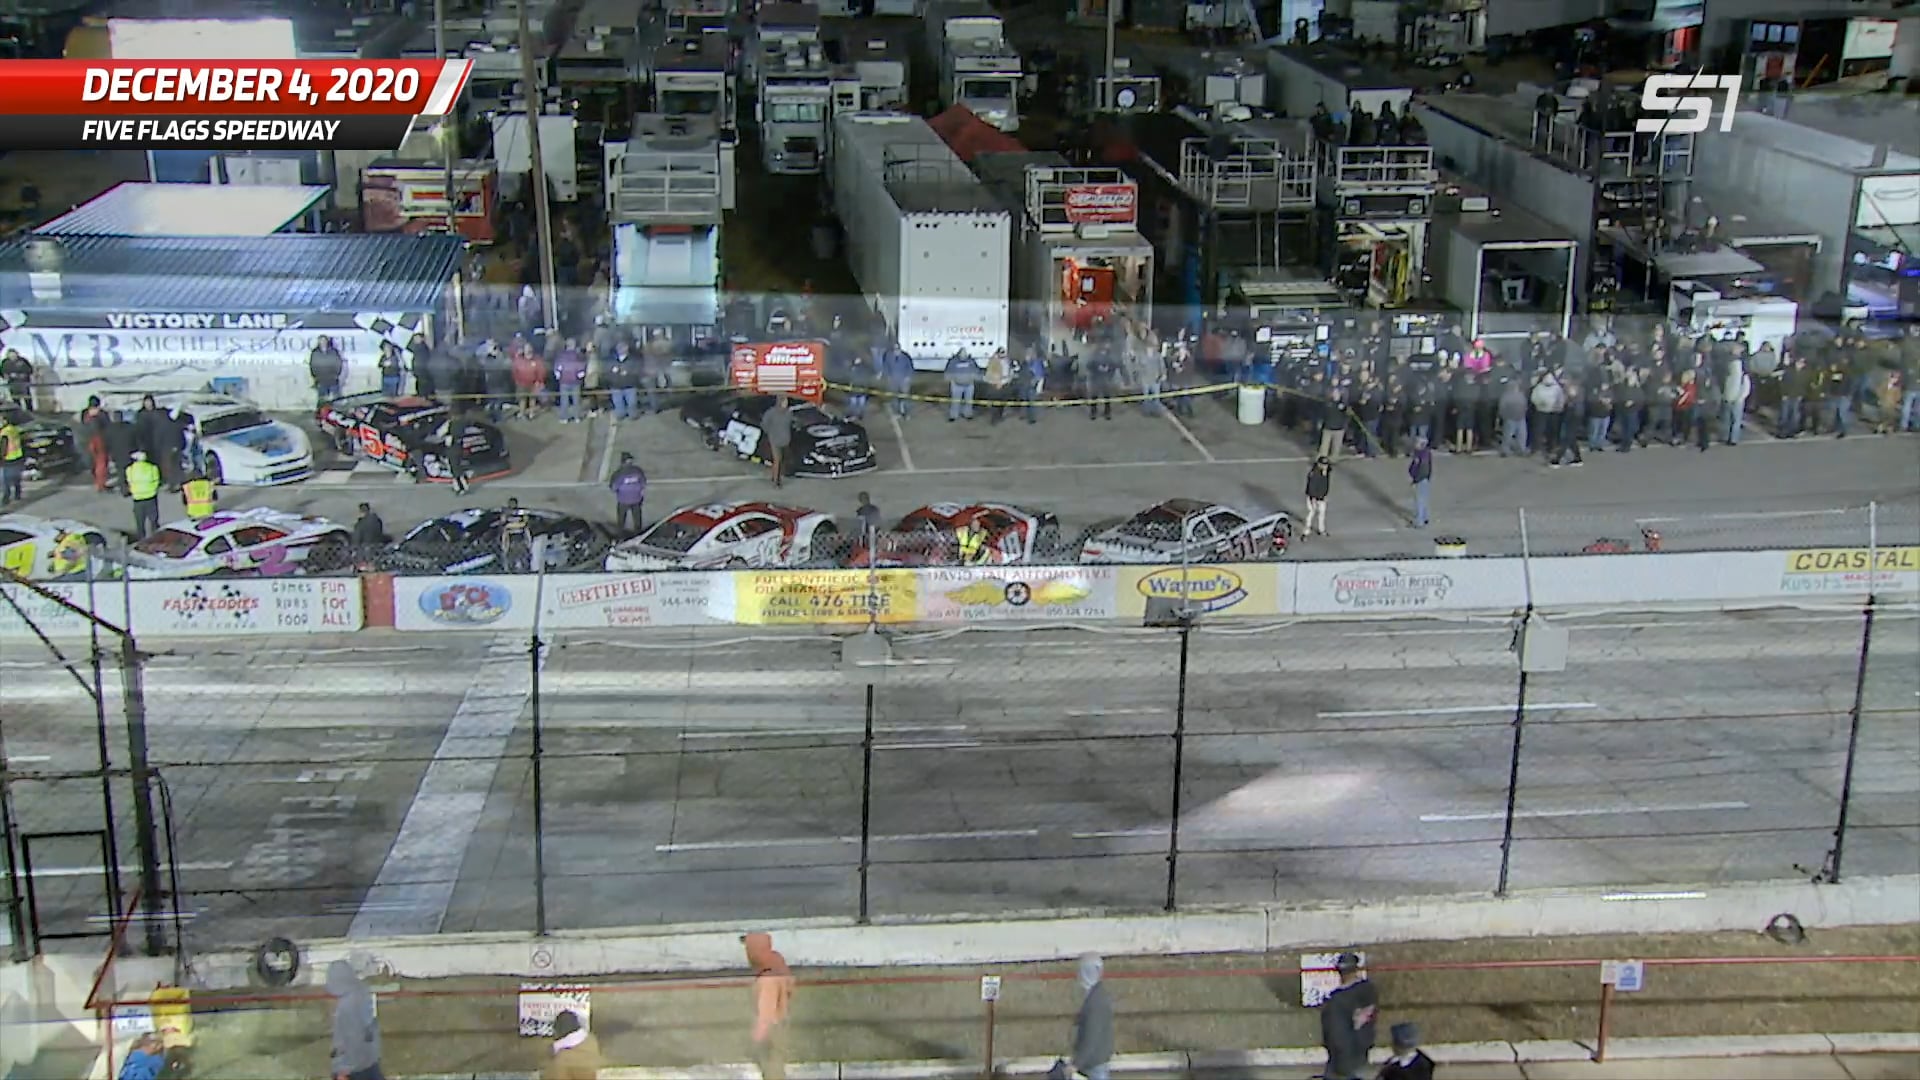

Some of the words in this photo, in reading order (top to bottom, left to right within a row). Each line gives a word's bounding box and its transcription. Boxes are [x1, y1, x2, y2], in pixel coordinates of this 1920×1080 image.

[107, 313, 215, 328] VICTORY
[223, 313, 288, 328] LANE
[1795, 551, 1913, 570] COASTAL
[561, 578, 652, 604] CERTIFIED
[1148, 575, 1232, 593] Wayne's
[163, 599, 200, 611] FAST
[769, 596, 800, 607] CALL
[321, 612, 351, 626] ALL!
